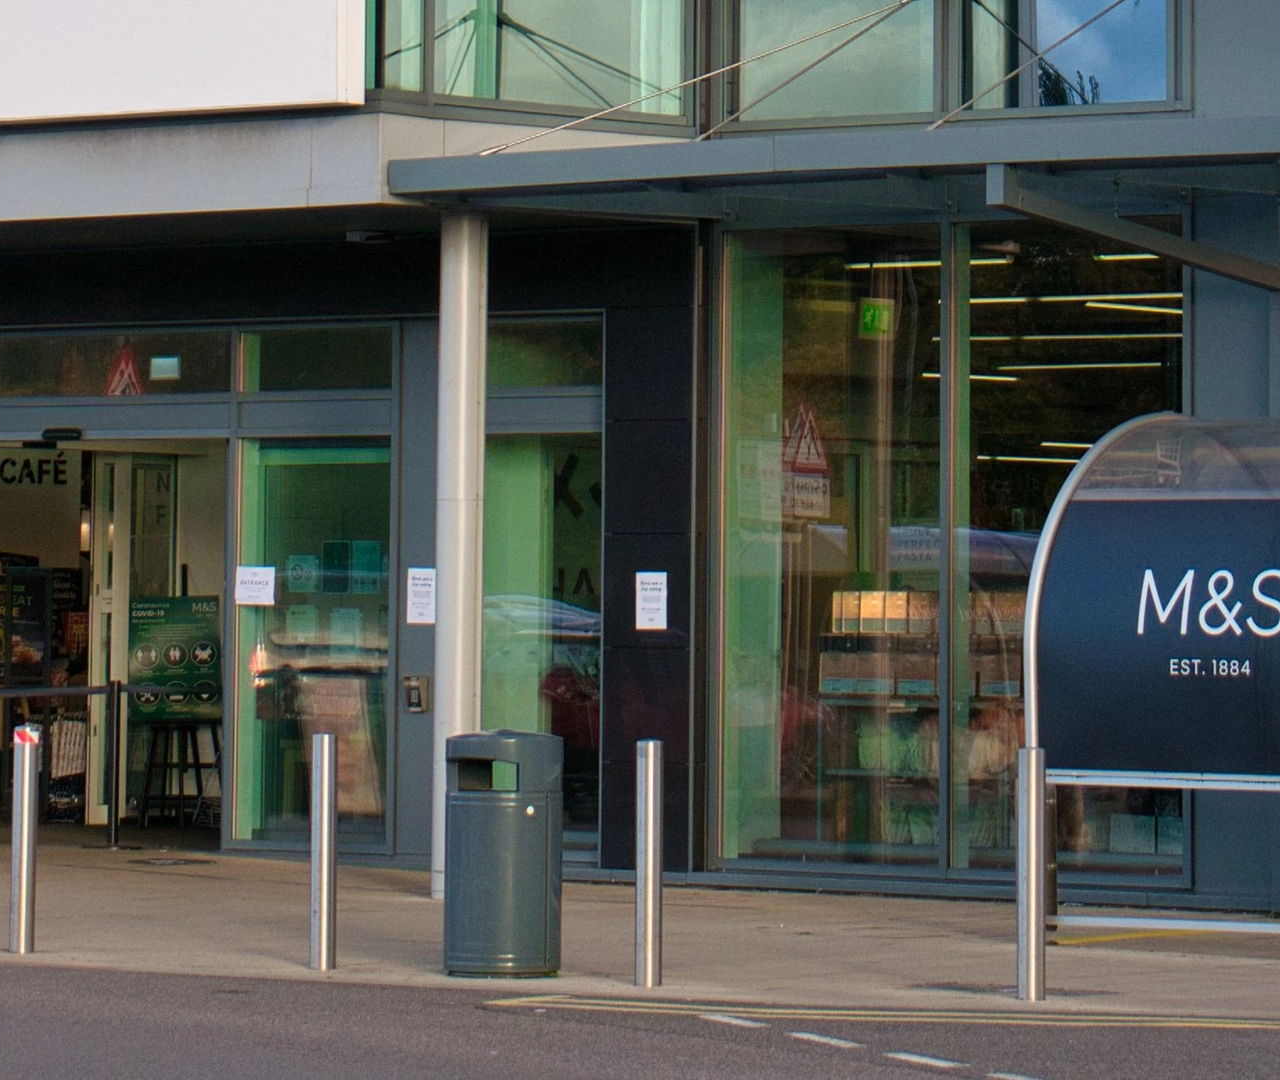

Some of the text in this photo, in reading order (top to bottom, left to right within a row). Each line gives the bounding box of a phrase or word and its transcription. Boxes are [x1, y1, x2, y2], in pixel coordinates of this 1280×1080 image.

[0, 451, 67, 484] CAFÉ
[898, 539, 941, 548] PERFEC
[192, 601, 217, 612] M&S
[131, 609, 165, 617] COVID-19
[1170, 659, 1251, 675] EST. 1884
